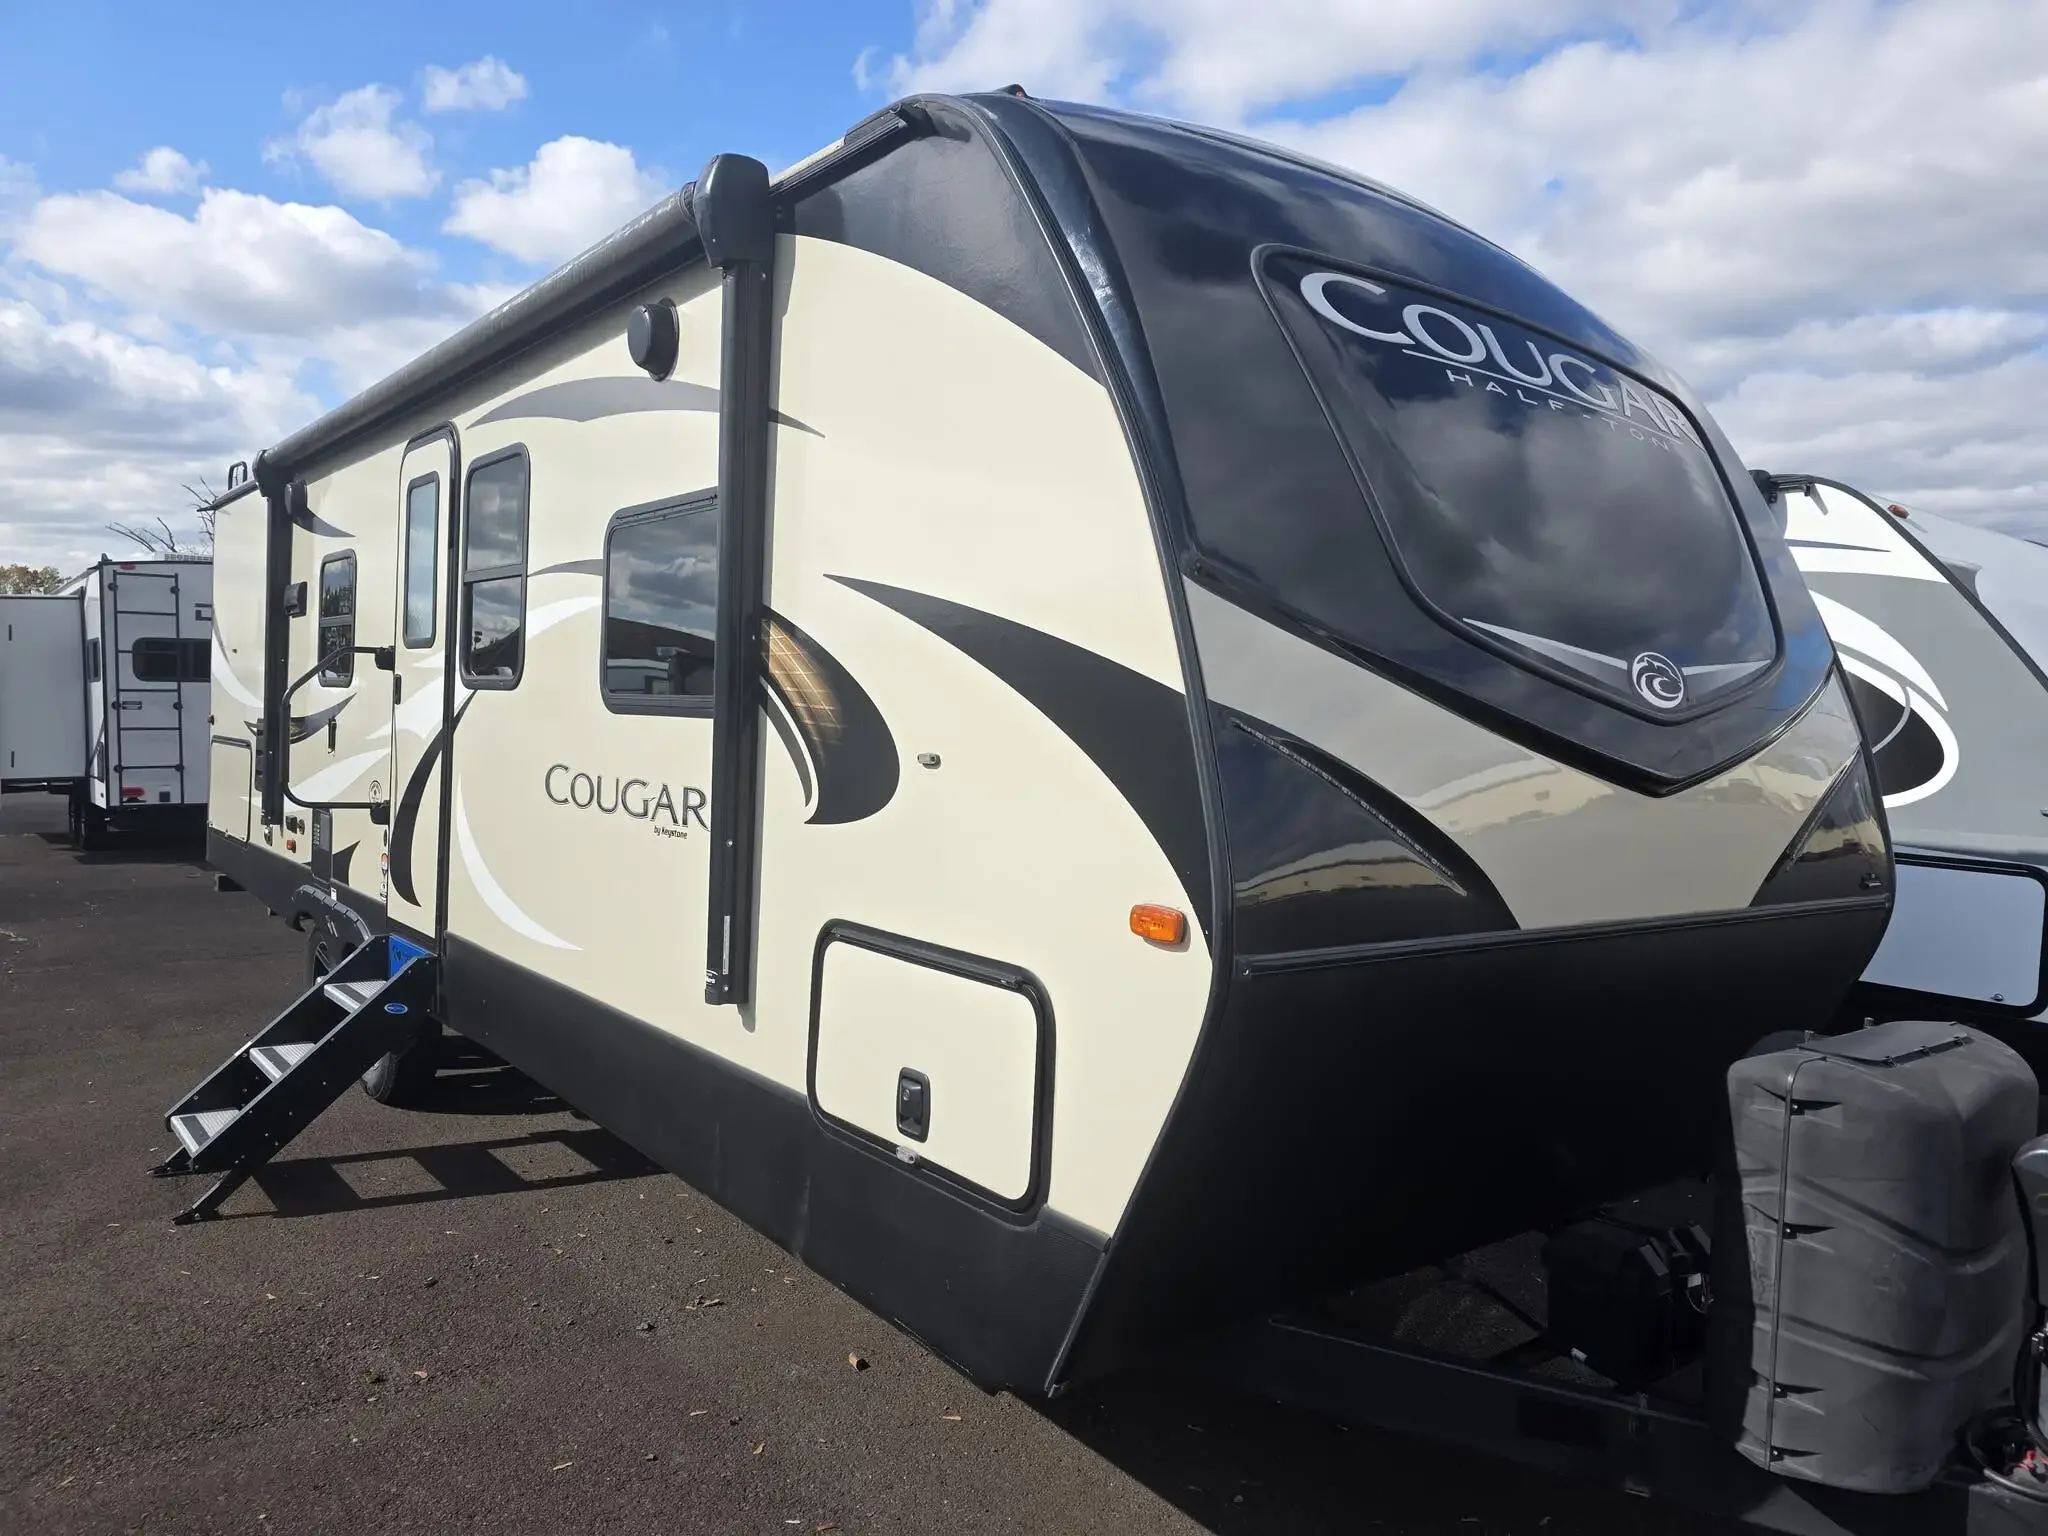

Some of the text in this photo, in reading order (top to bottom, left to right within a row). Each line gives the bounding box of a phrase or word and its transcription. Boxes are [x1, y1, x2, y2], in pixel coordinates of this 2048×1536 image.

[1300, 272, 1705, 452] COUGAR
[1446, 369, 1670, 452] HALF-TON
[545, 763, 710, 832] COUGAR
[653, 825, 661, 836] by
